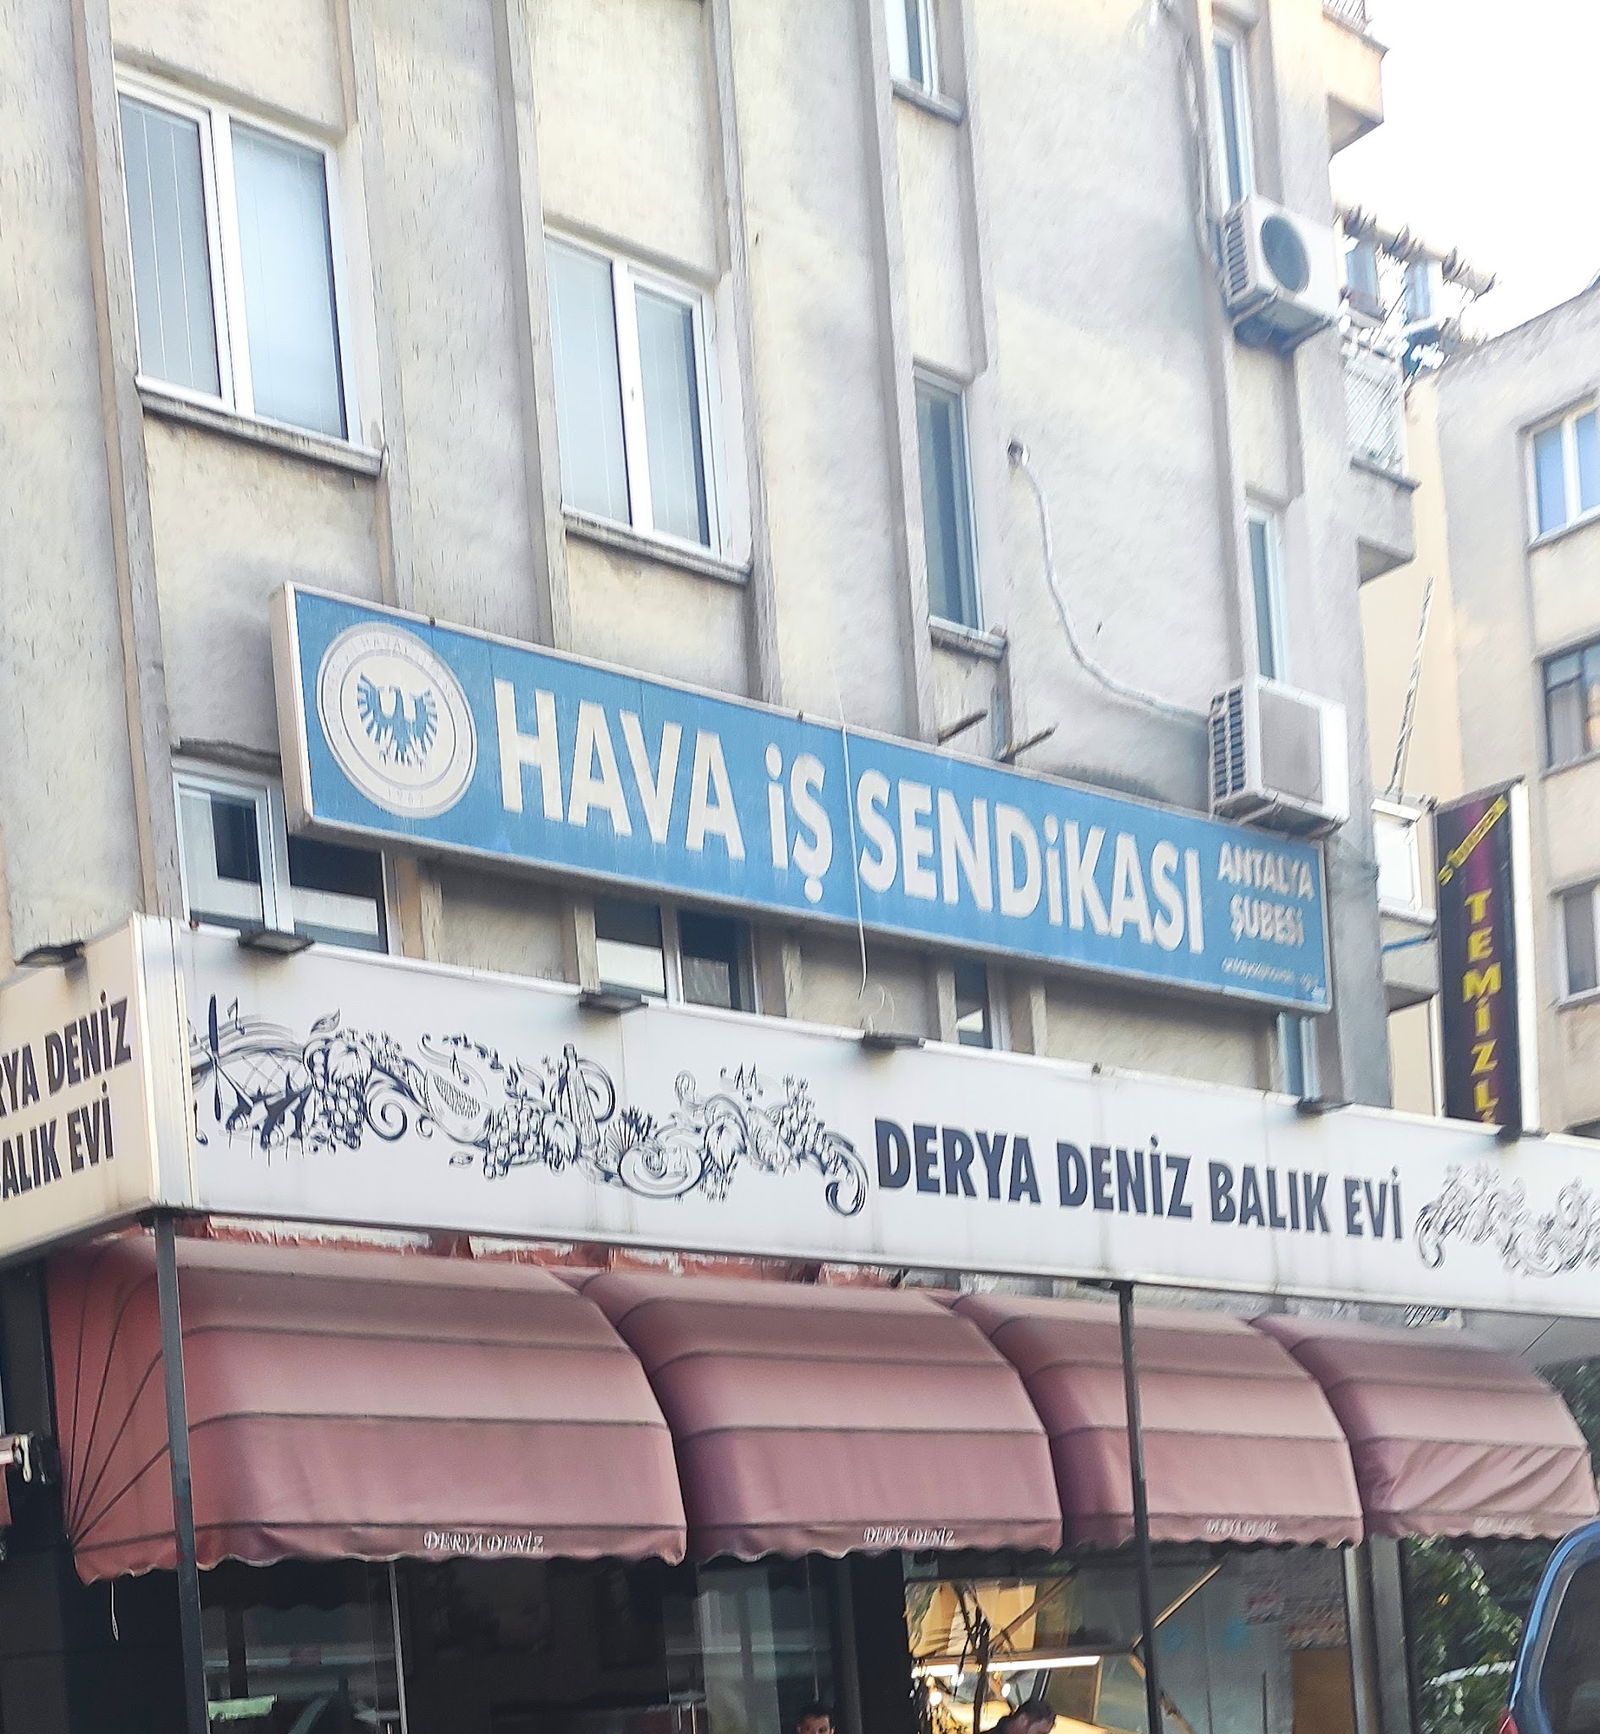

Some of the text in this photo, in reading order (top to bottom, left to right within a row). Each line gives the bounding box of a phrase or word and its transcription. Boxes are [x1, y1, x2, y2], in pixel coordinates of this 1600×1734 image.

[494, 677, 746, 861] HAVA
[1217, 841, 1316, 902] ANTALYA
[45, 989, 132, 1095] DENİZ
[67, 1080, 114, 1174] EVİ
[874, 1116, 1403, 1240] DERYA DENİZ BALIK EVİ
